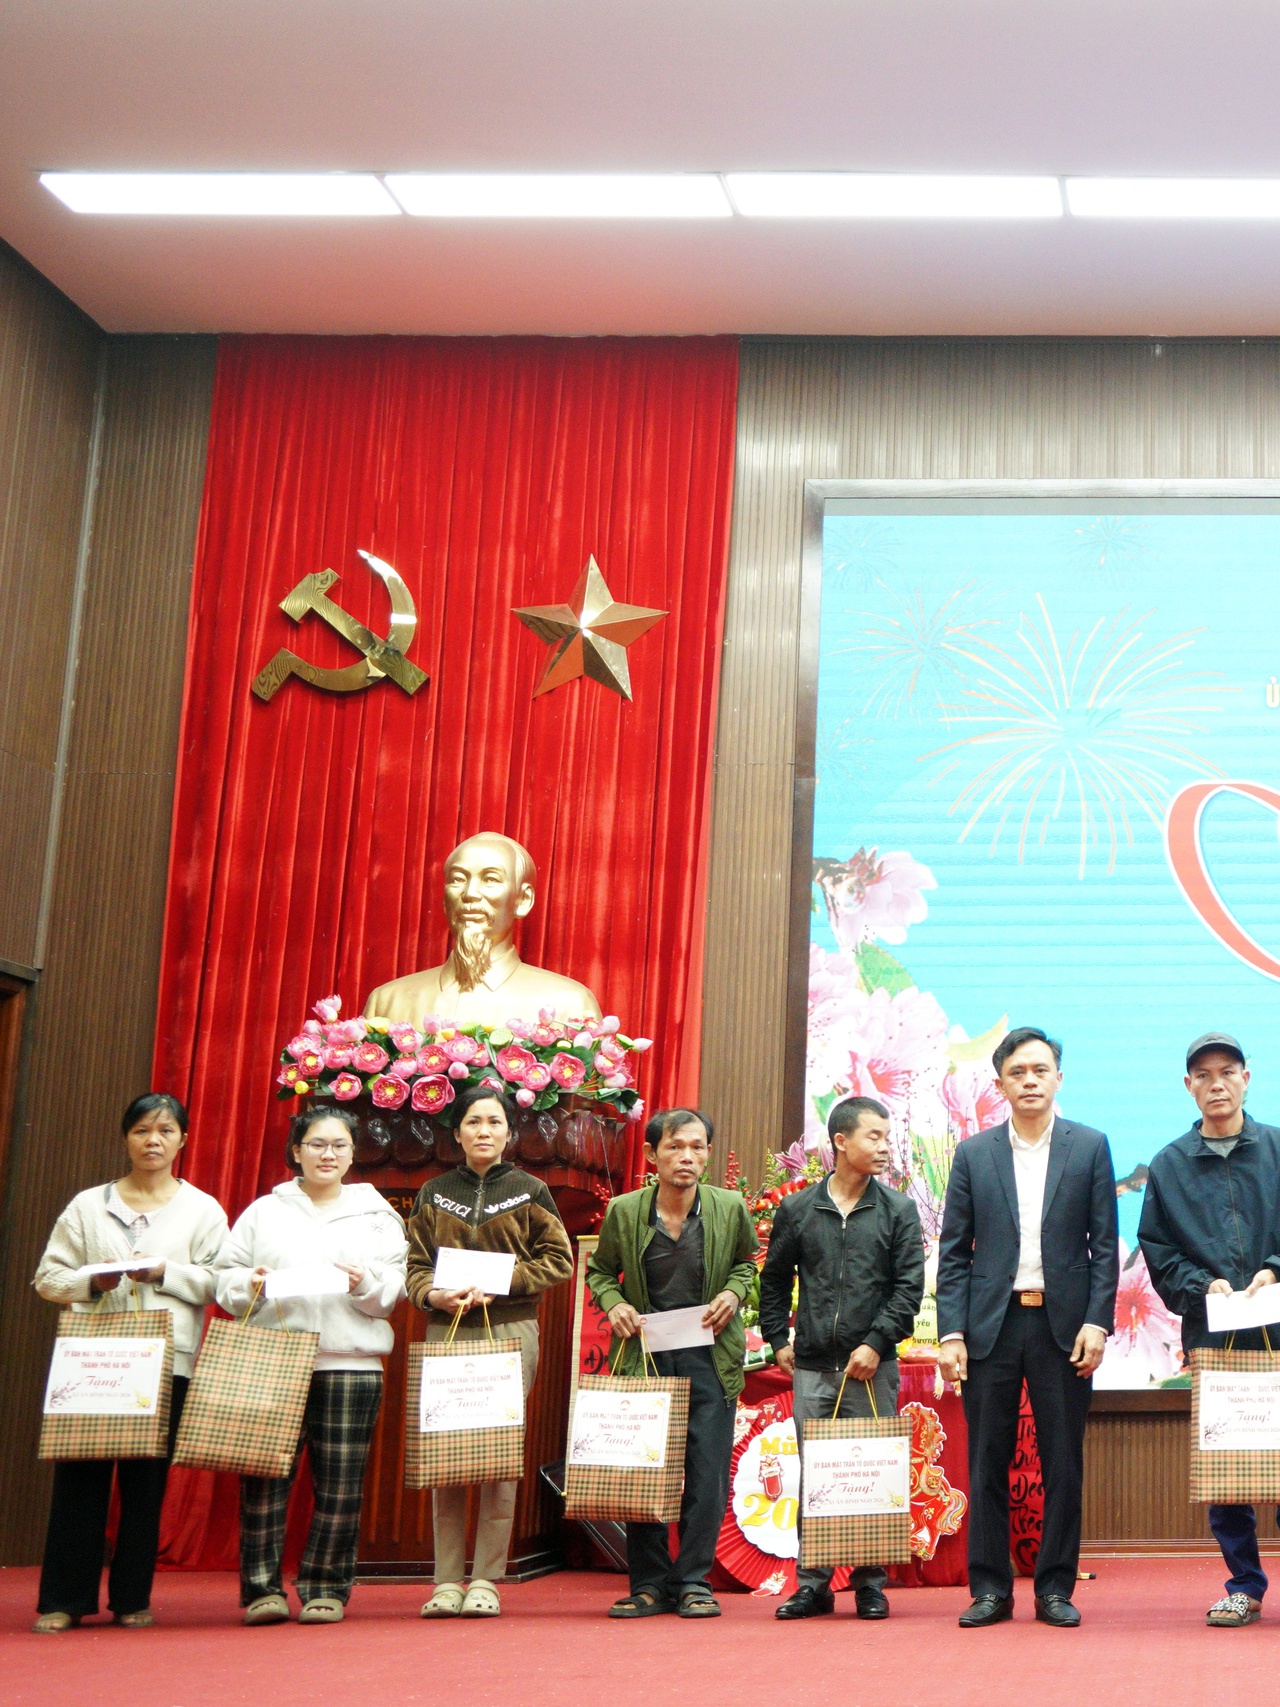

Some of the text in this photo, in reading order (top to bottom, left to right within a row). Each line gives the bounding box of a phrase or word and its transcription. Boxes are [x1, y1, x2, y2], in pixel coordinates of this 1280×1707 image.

[500, 1193, 531, 1210] adidas
[912, 1336, 937, 1345] hương
[85, 1375, 124, 1389] Tặng!
[838, 1481, 875, 1496] Tặng!
[740, 1492, 799, 1531] 20
